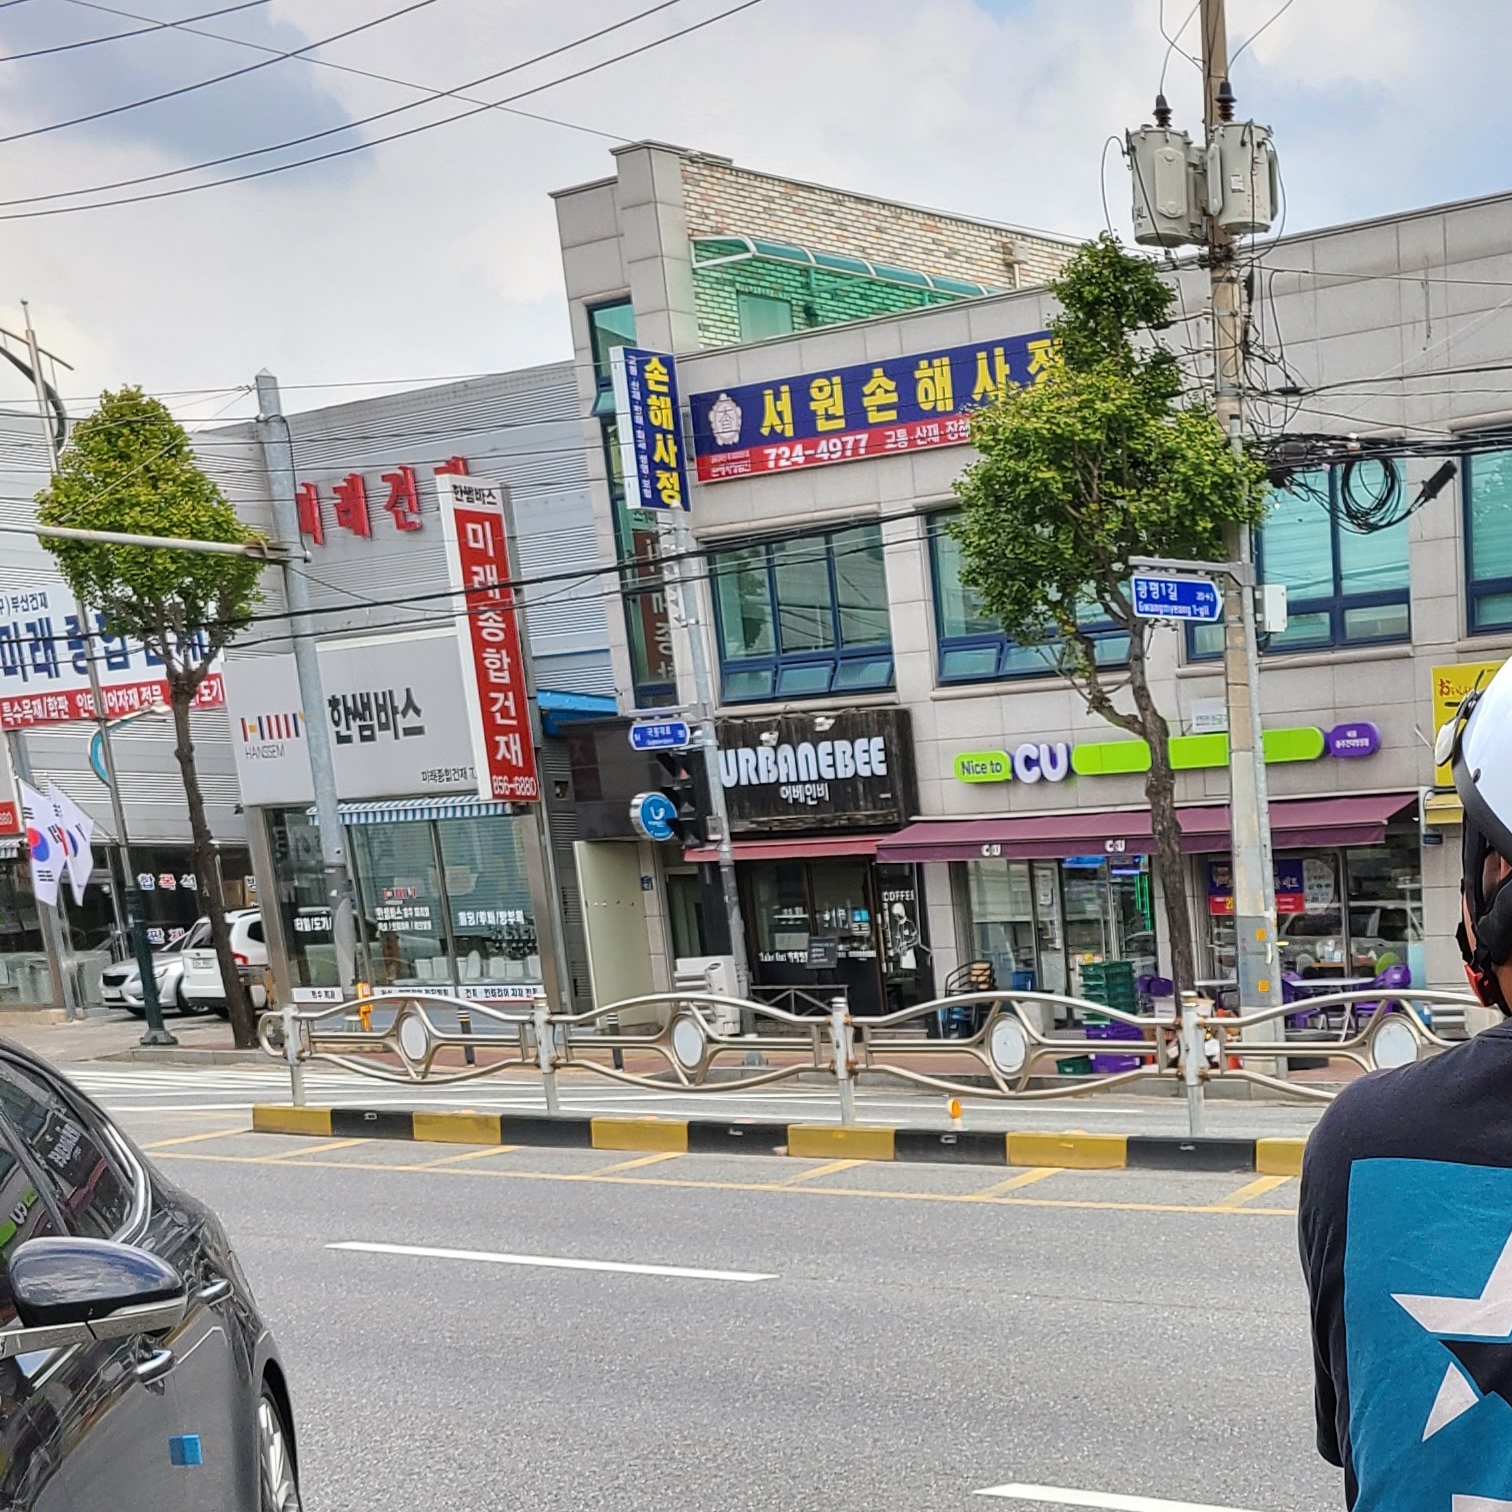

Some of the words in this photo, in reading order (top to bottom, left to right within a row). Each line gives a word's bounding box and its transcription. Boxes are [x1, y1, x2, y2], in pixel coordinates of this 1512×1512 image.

[643, 356, 682, 506] 손해사정
[763, 433, 869, 469] 724-4977
[1136, 580, 1179, 601] 광명1길
[464, 520, 524, 768] 미래종합건재
[245, 744, 286, 760] HANSSEM
[717, 736, 888, 789] URBANEBEE
[960, 760, 988, 776] Nice
[989, 759, 1003, 773] to
[1013, 742, 1069, 784] CU
